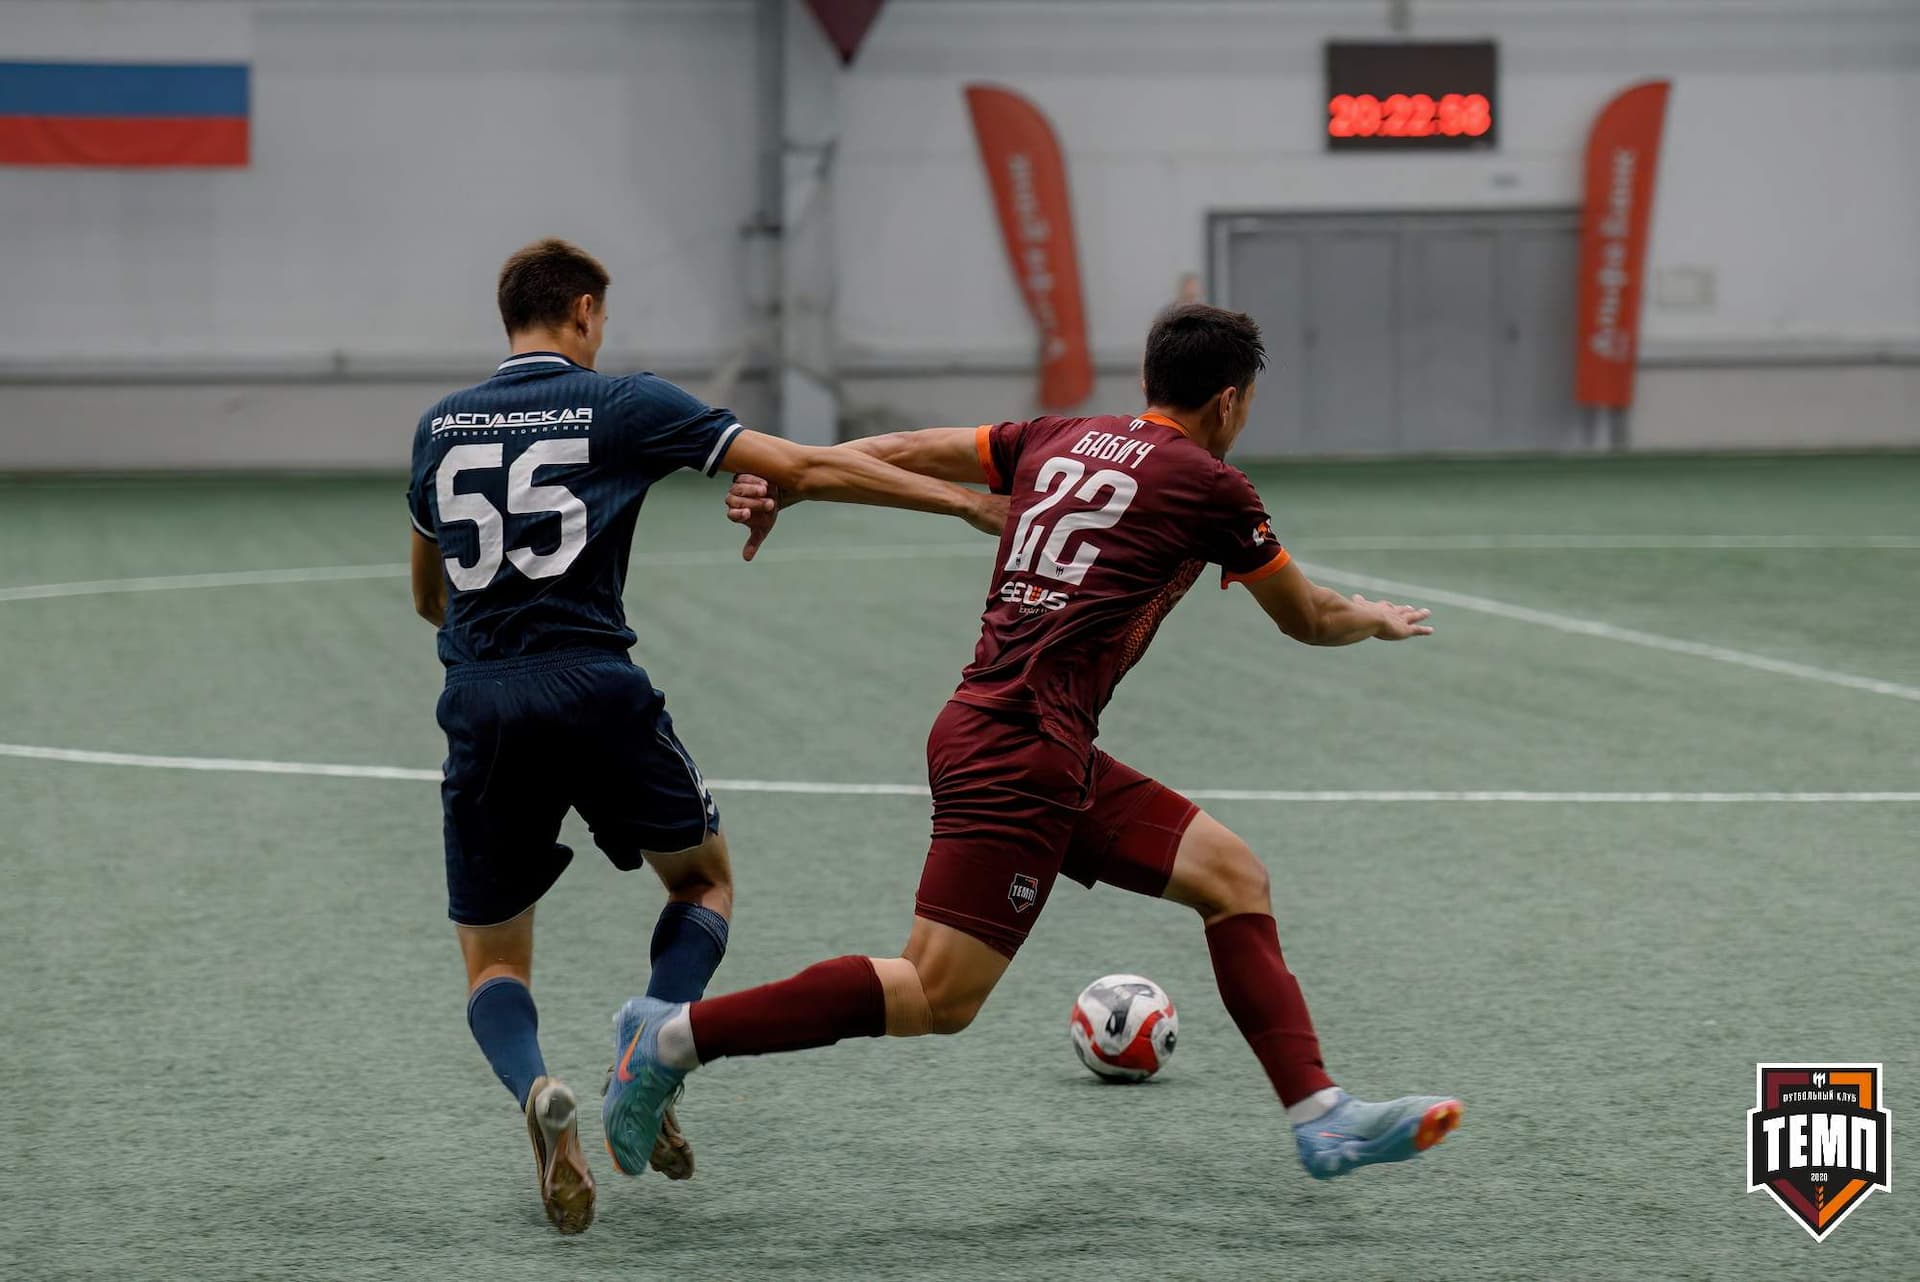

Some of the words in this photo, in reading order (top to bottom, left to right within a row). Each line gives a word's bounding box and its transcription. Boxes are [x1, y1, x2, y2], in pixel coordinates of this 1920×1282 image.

[431, 408, 592, 432] РАСПАДСКАЯ
[1070, 431, 1155, 469] БАБИЧ
[436, 437, 590, 591] 55
[1004, 456, 1138, 585] 22
[1012, 884, 1036, 902] ТЕМП
